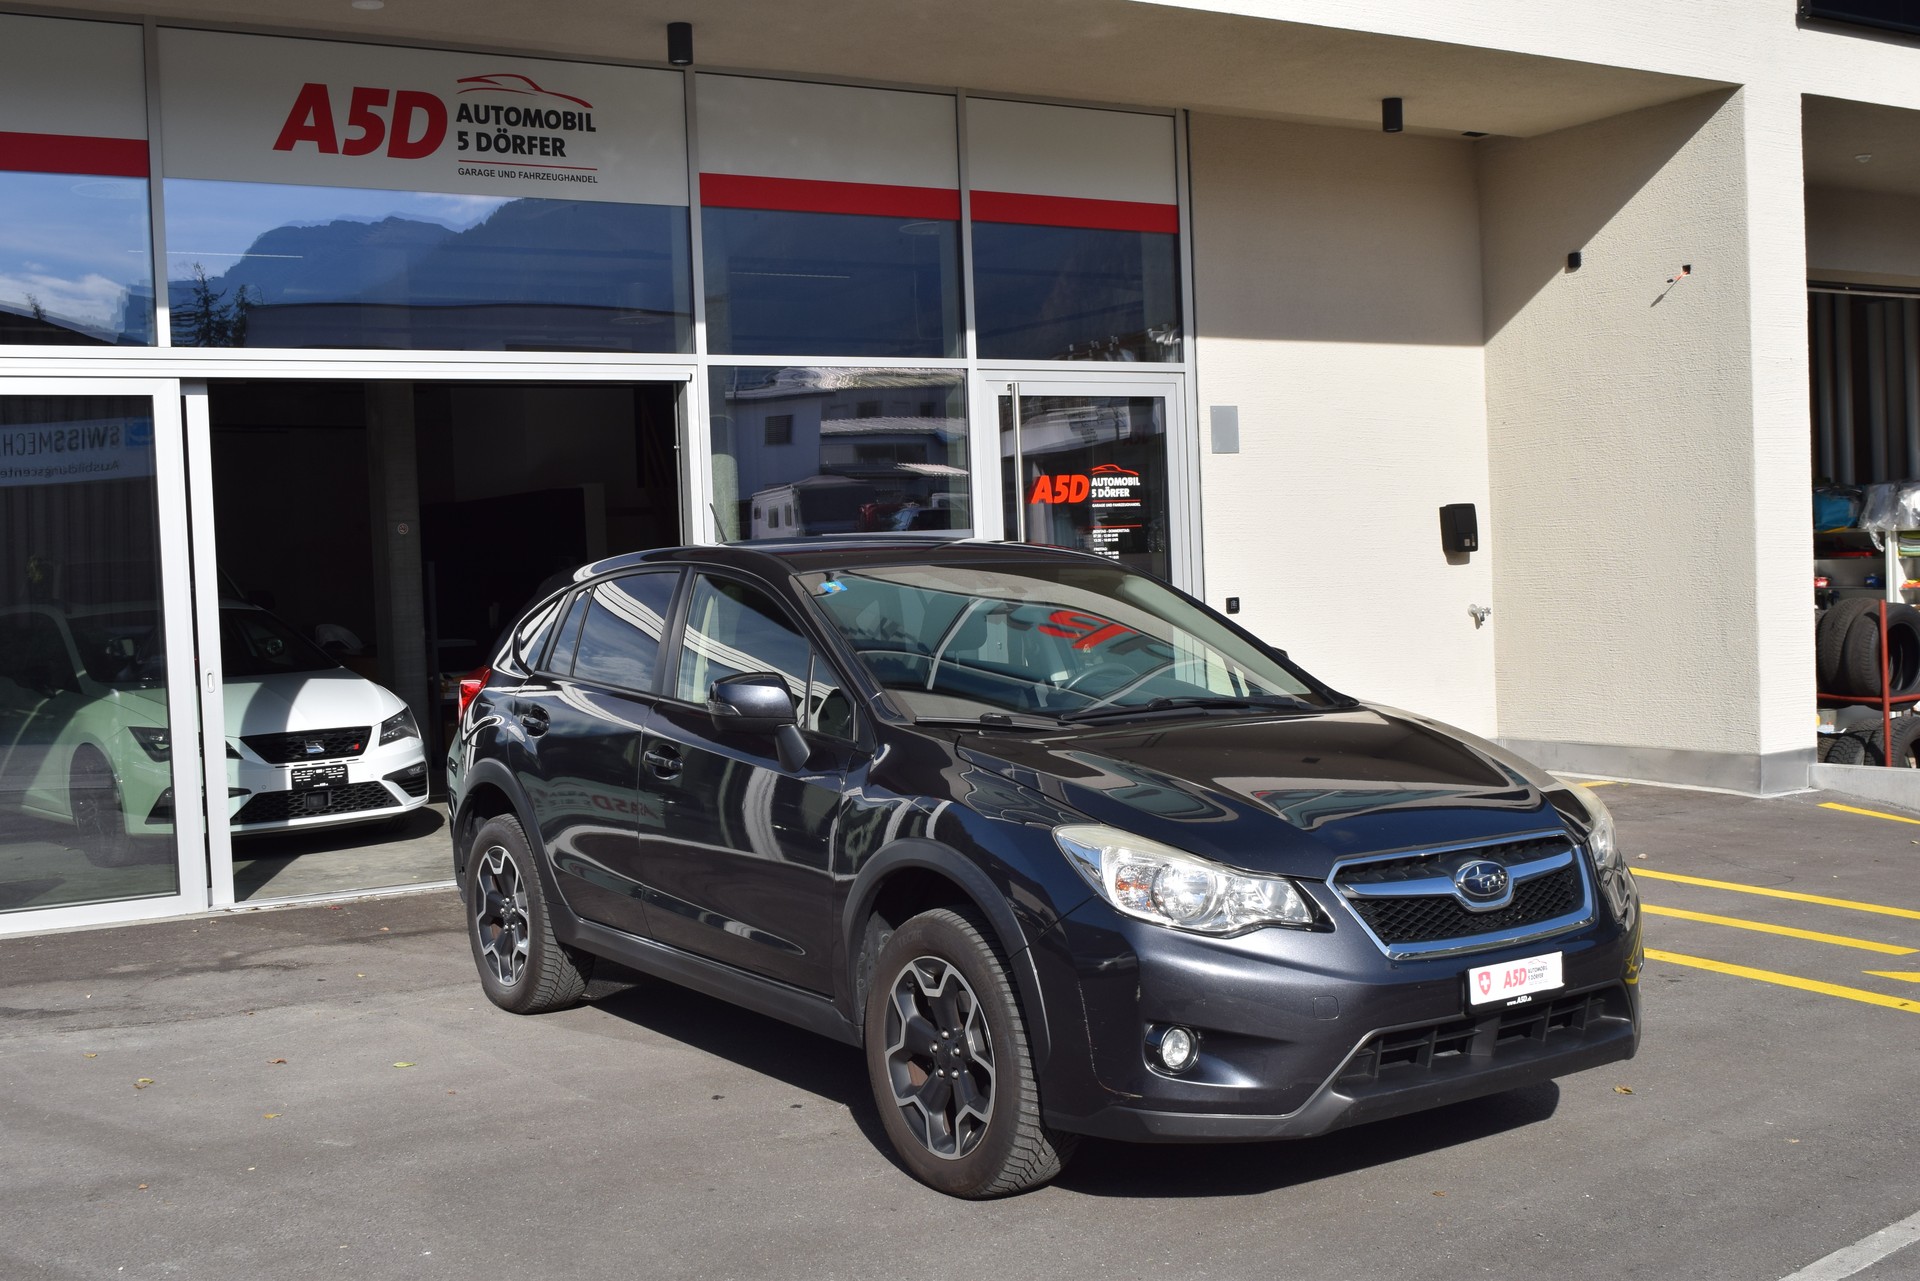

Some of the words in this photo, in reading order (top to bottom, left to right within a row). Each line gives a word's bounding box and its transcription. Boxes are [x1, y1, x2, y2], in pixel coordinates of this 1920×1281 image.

[272, 82, 448, 160] A5D
[456, 103, 597, 133] AUTOMOBIL
[457, 131, 470, 151] 5
[476, 128, 567, 158] DÖRFER
[458, 167, 496, 179] GARAGE
[497, 170, 517, 180] UND
[518, 170, 598, 184] FAHRZEUGHANDEL
[1031, 475, 1090, 505] A5D
[1091, 477, 1141, 487] AUTOMOBIL
[1091, 488, 1097, 498] 5
[1098, 486, 1130, 498] DÖRFER
[1503, 968, 1527, 989] A5D
